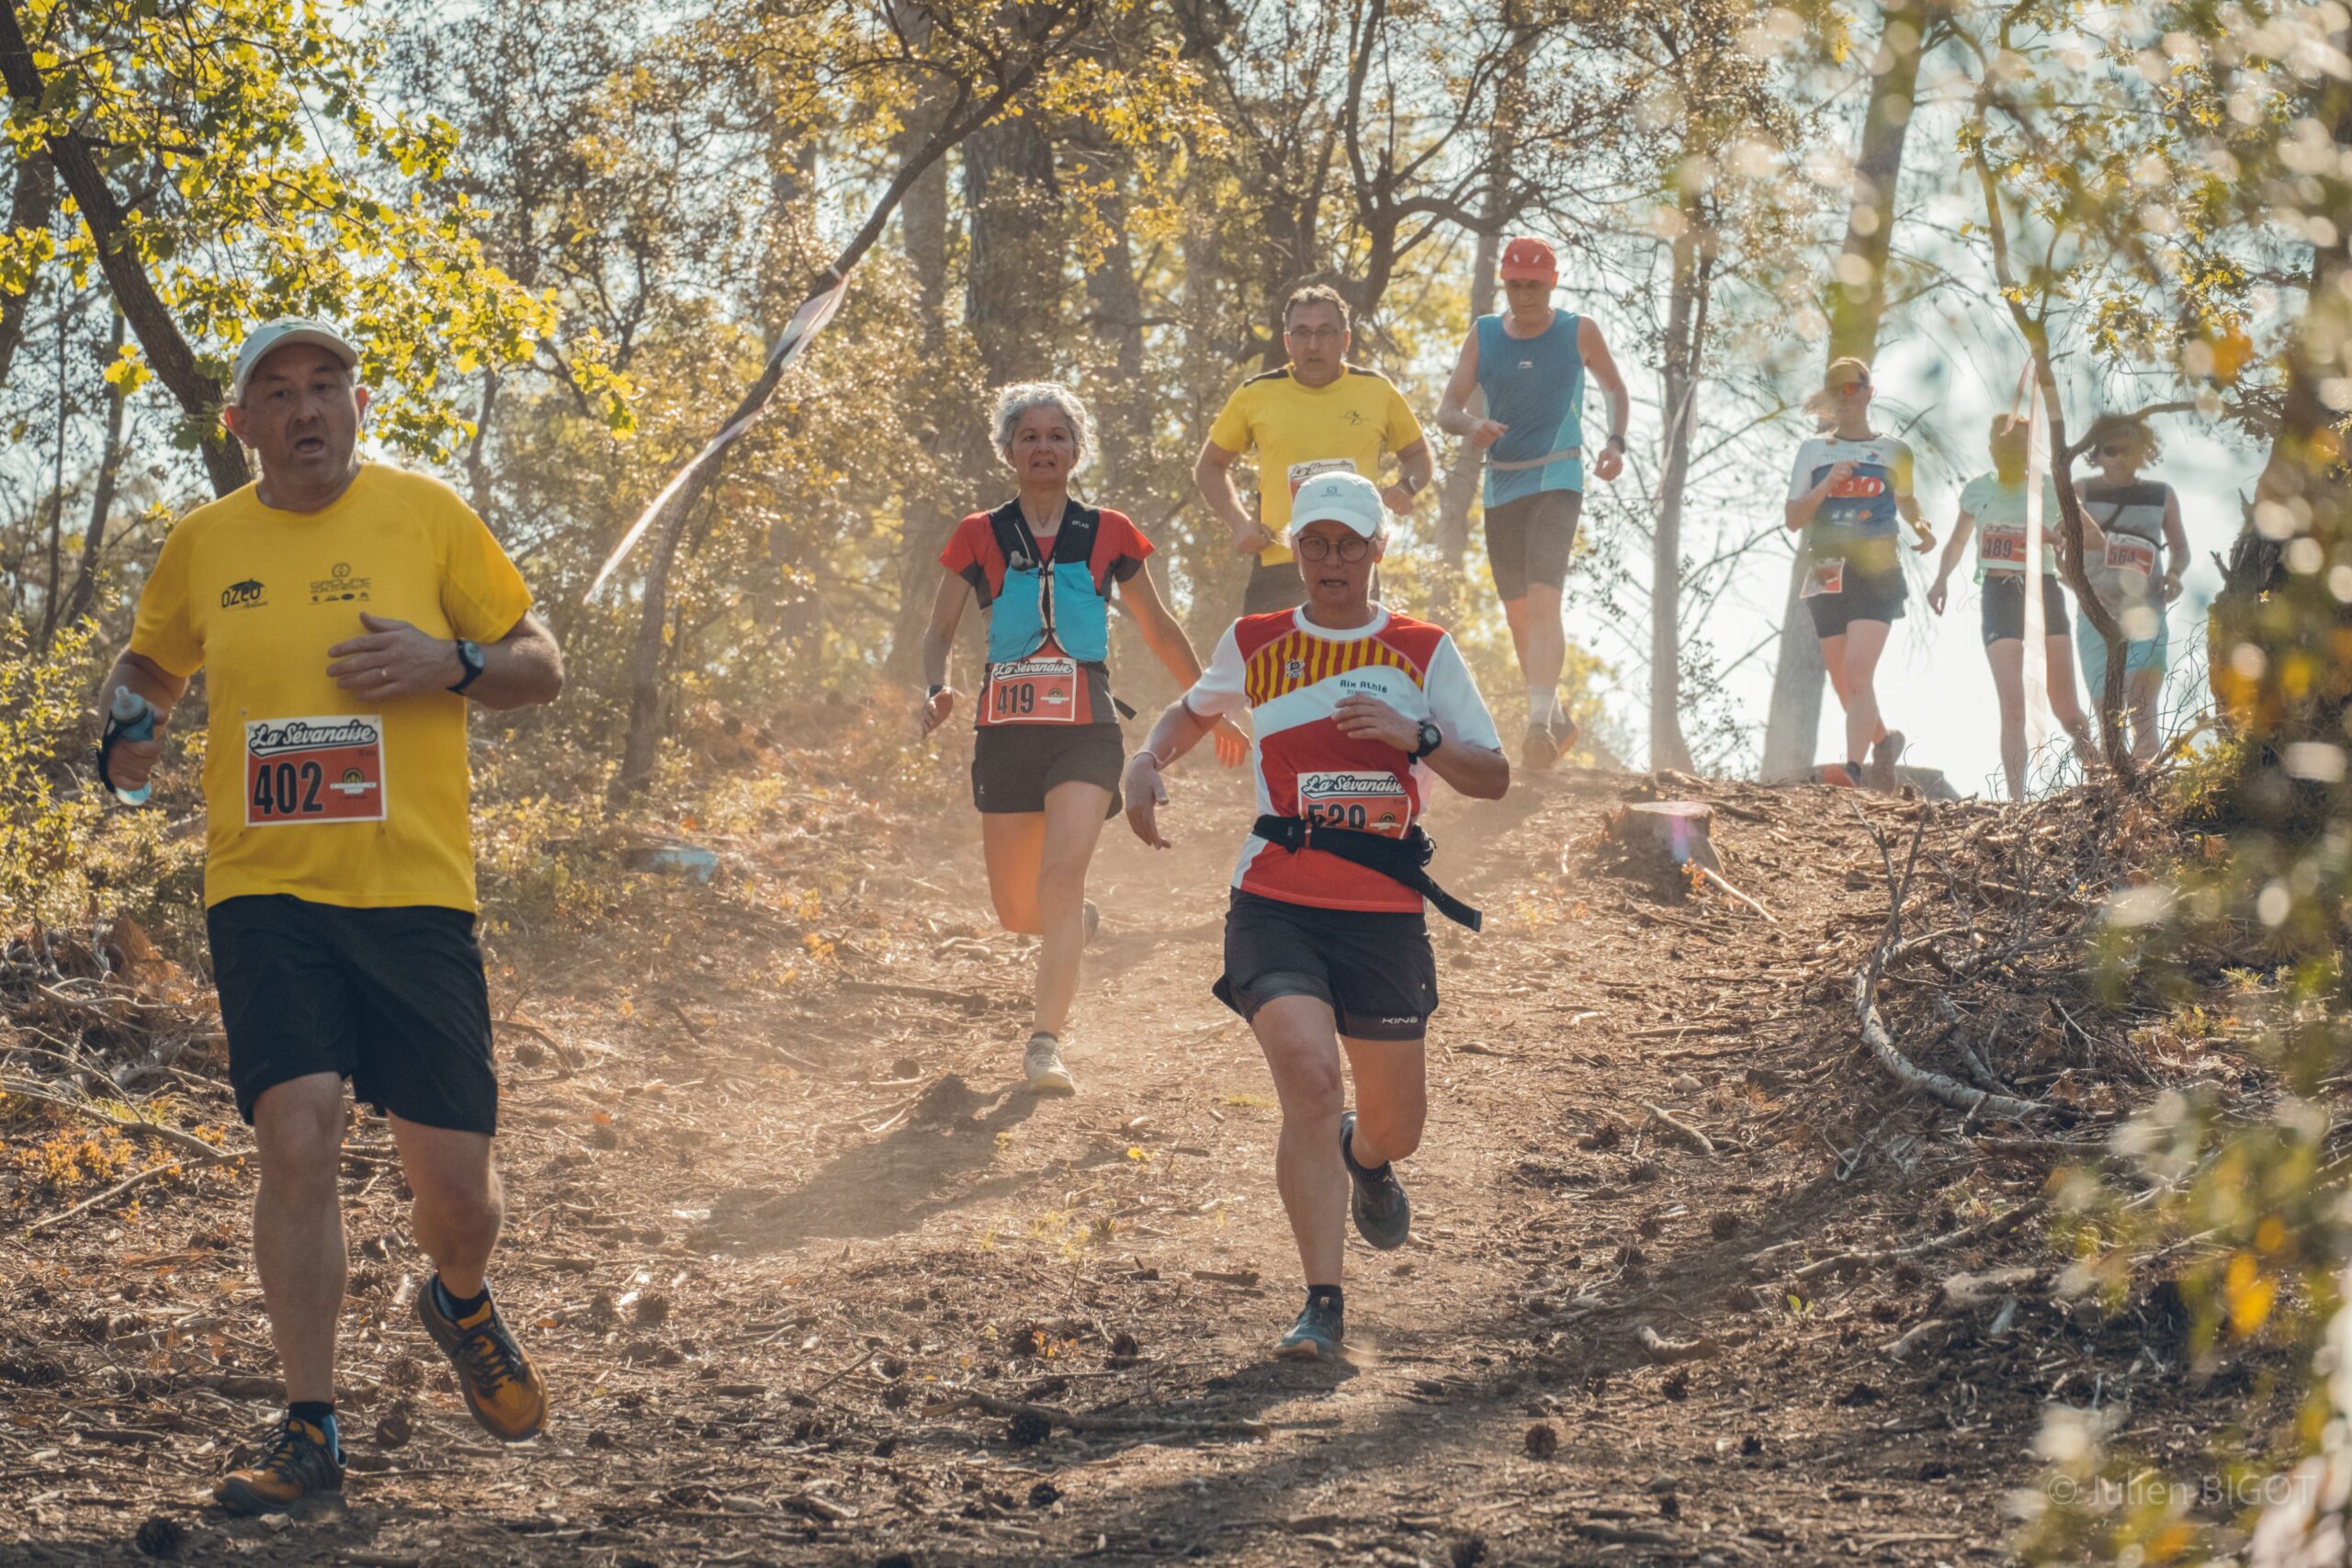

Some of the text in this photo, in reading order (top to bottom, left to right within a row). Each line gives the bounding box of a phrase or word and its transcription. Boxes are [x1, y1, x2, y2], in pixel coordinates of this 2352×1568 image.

[995, 663, 1014, 677] La
[1340, 679, 1357, 688] Aix
[996, 682, 1035, 715] 419
[250, 719, 378, 748] La Sévanaise
[253, 761, 323, 816] 402
[1303, 775, 1406, 795] La Sévanaise
[1307, 803, 1366, 830] 520
